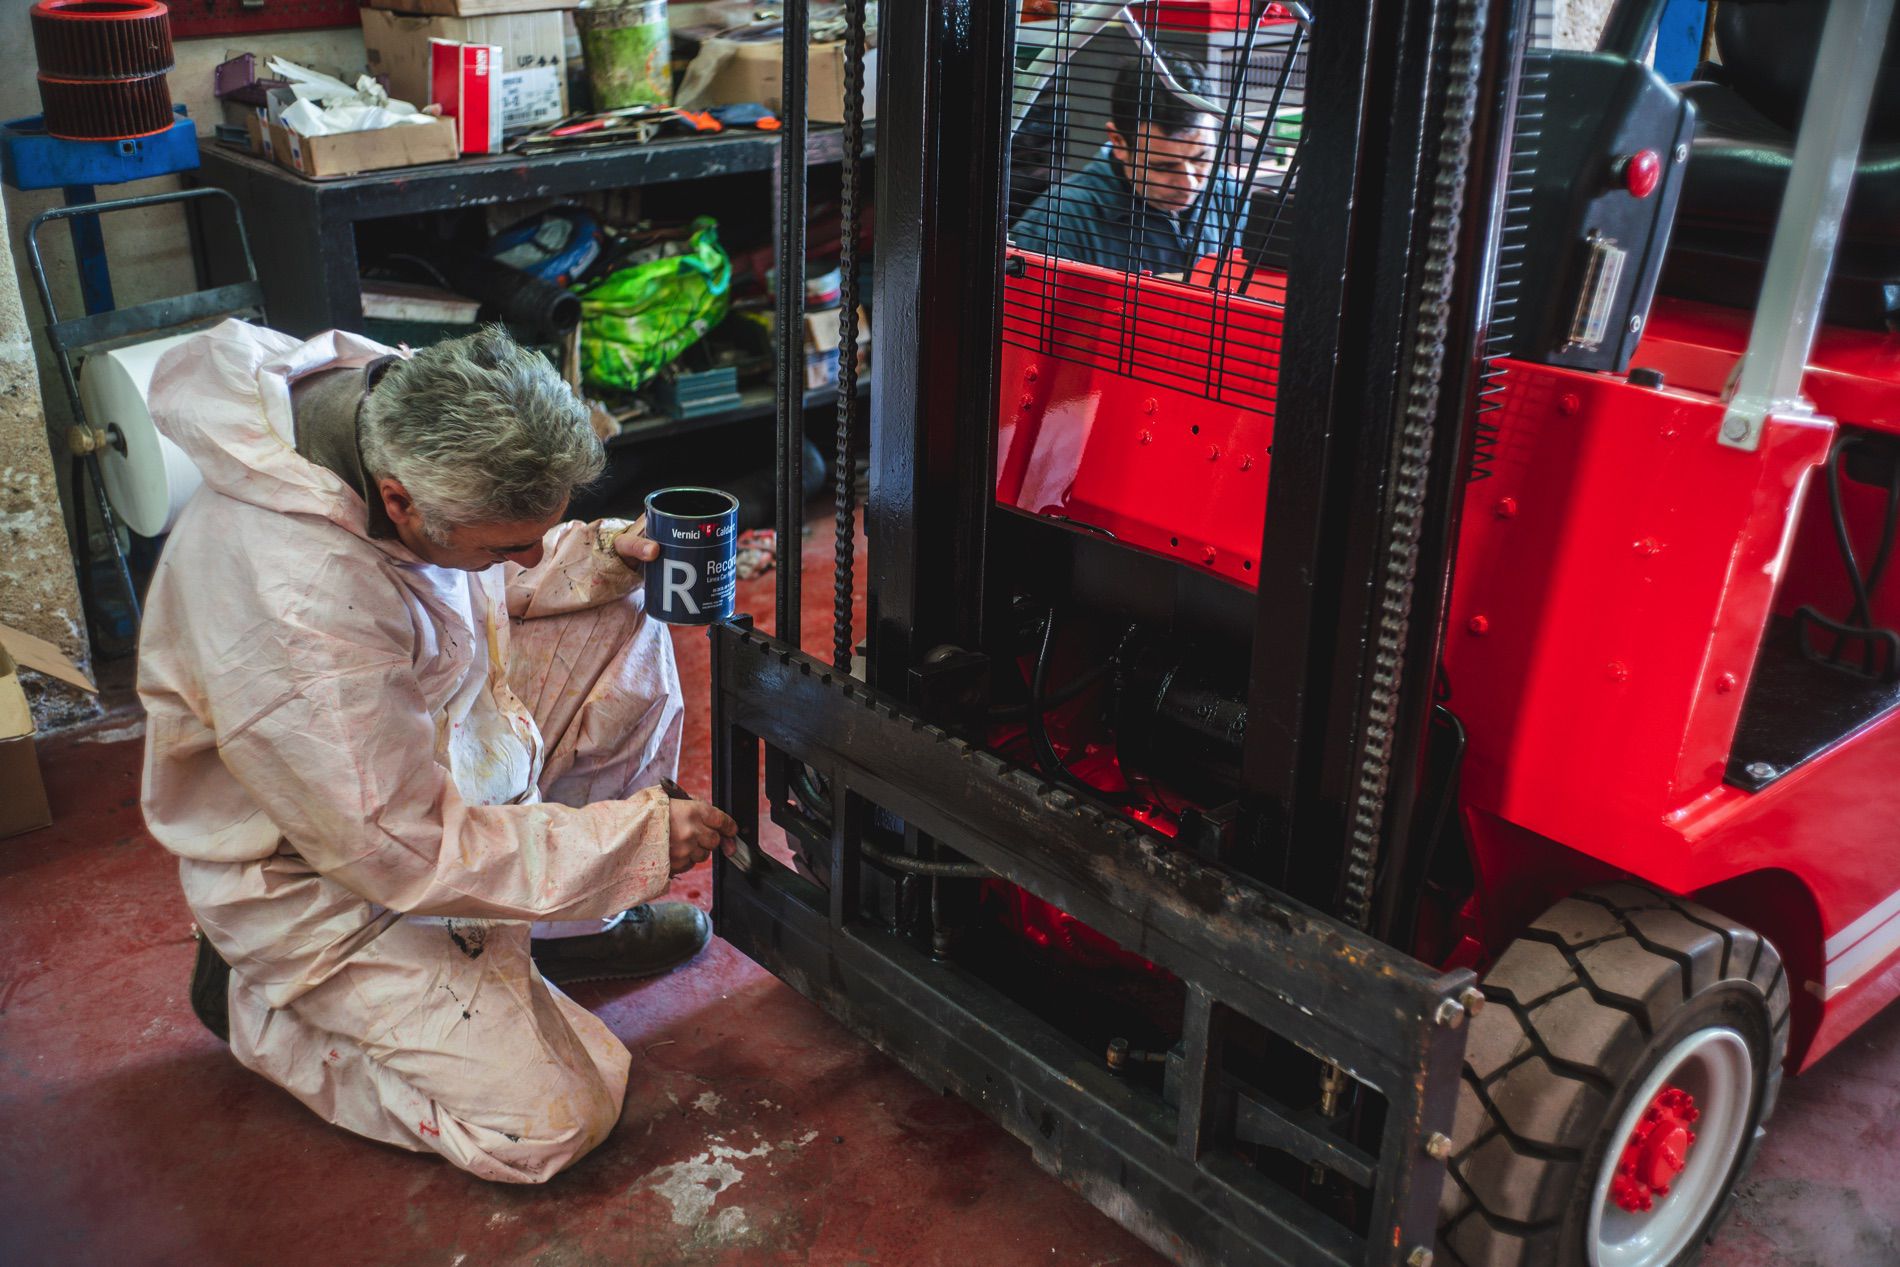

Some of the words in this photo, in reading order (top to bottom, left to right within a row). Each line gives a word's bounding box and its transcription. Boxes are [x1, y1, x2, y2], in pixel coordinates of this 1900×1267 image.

[517, 55, 534, 67] UP
[671, 528, 701, 541] Vernici
[662, 558, 701, 615] R
